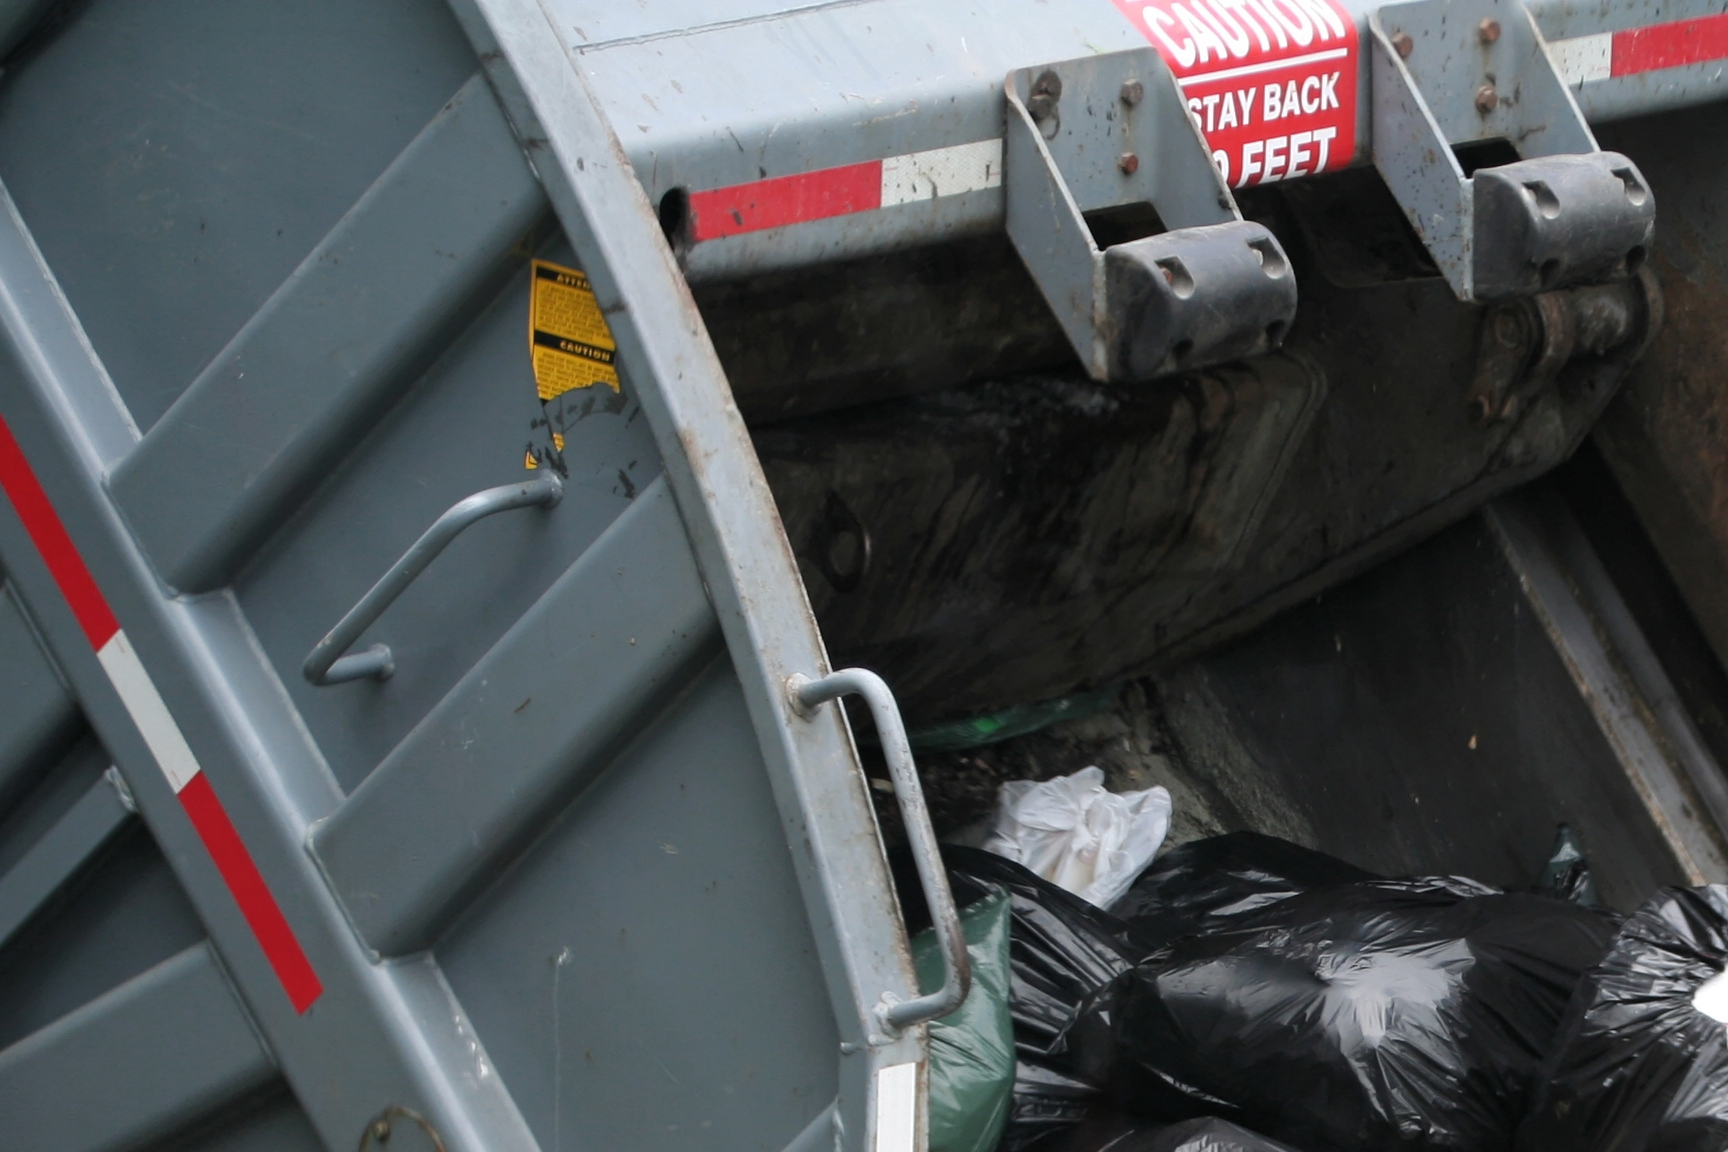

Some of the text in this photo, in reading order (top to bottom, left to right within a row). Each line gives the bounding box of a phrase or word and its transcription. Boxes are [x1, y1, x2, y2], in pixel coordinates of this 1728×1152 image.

[1142, 0, 1346, 68] CAUTION
[1187, 71, 1341, 133] STAY BACK
[1235, 126, 1337, 189] FEET
[559, 340, 611, 362] CAUTION
